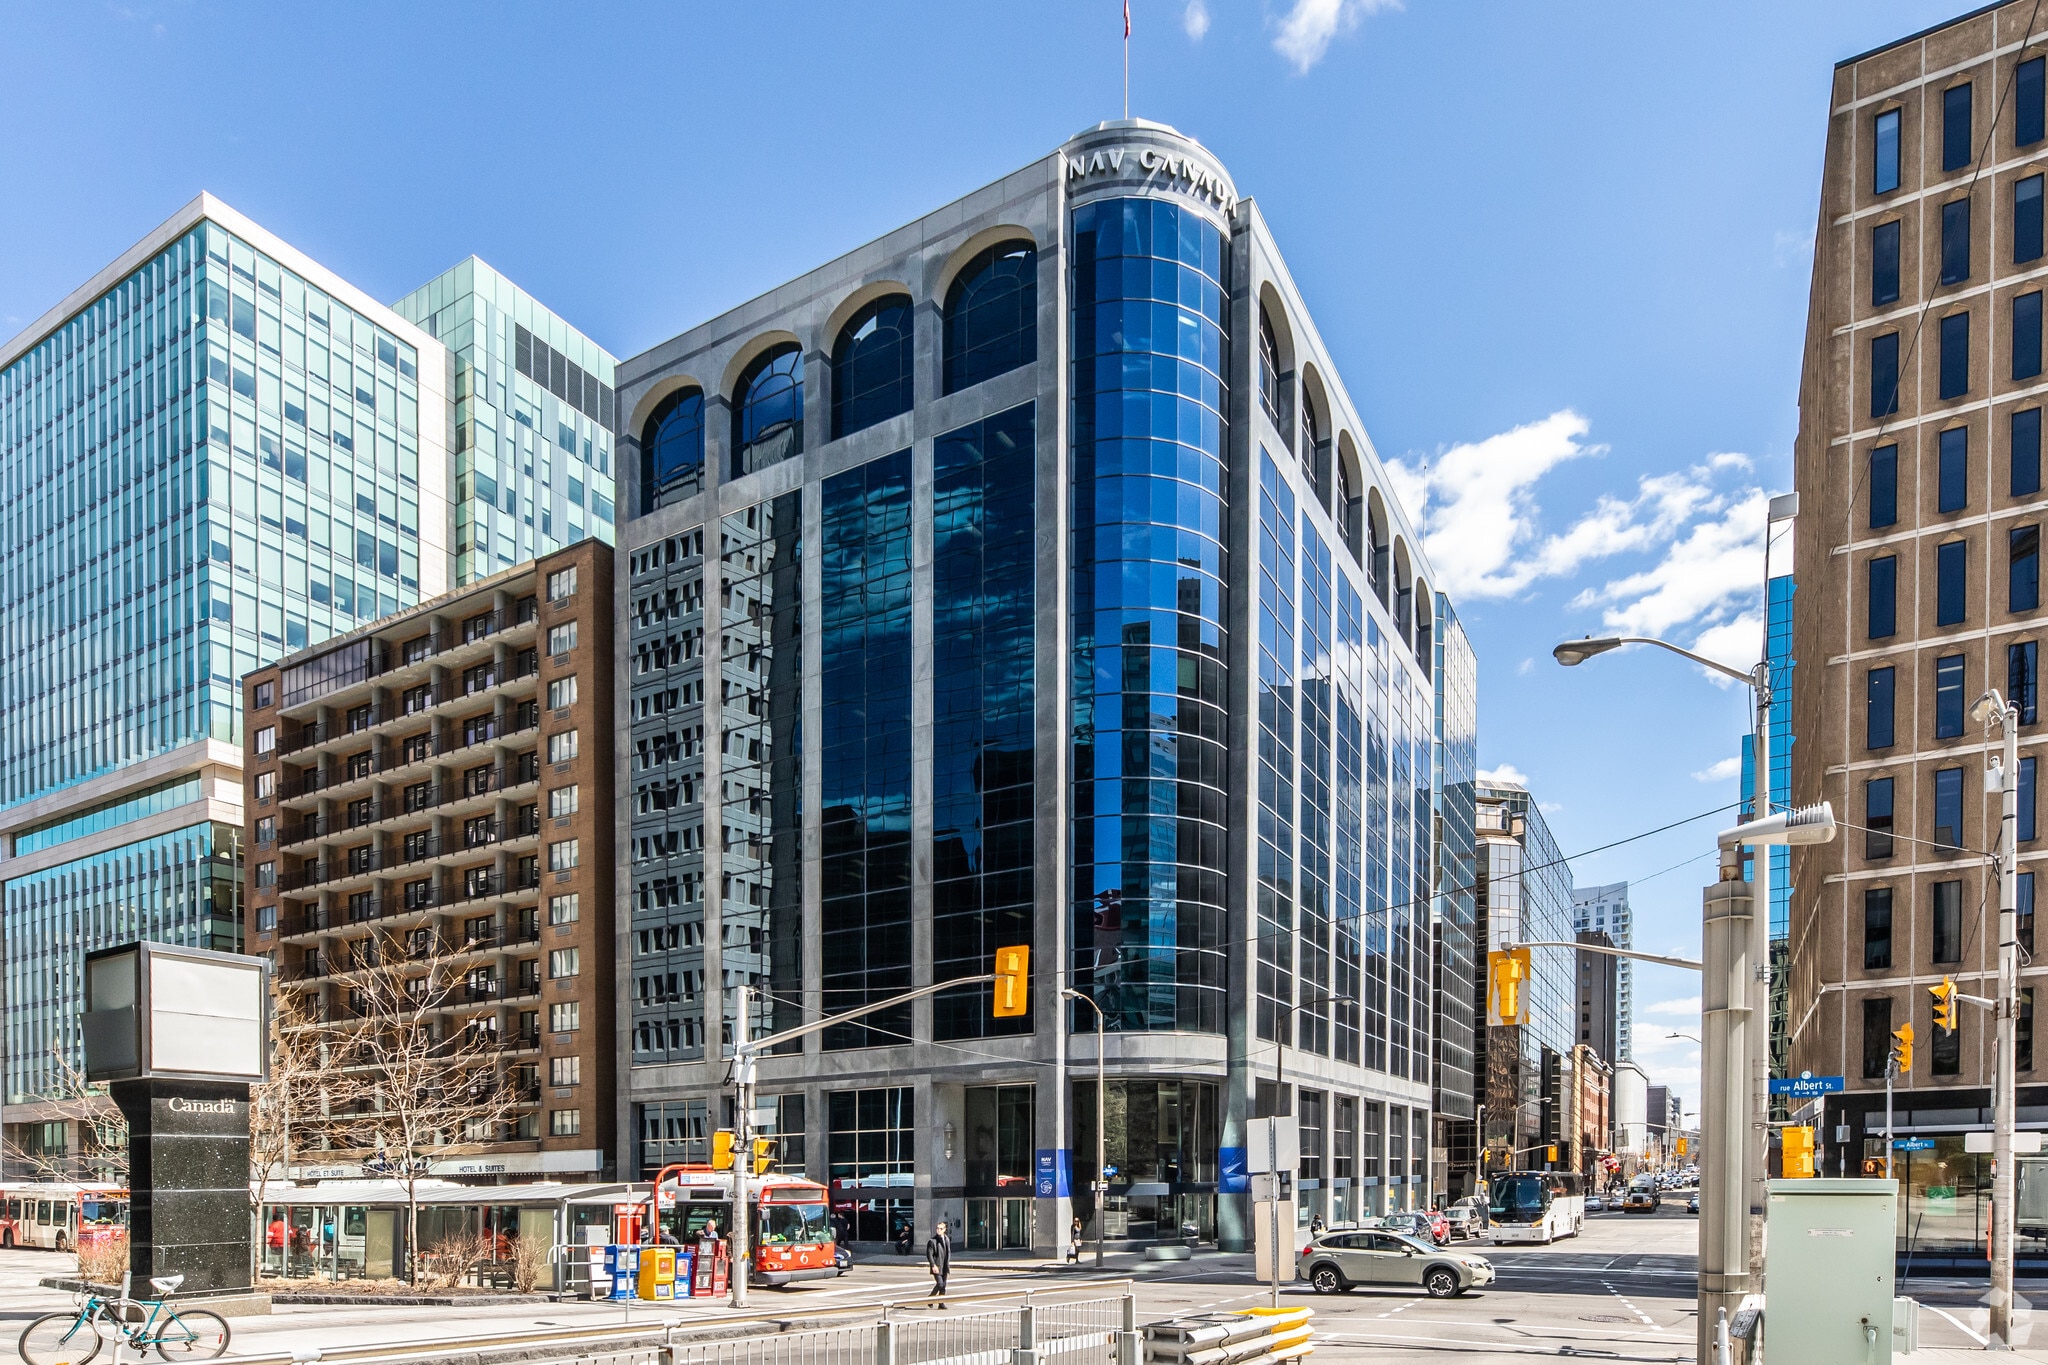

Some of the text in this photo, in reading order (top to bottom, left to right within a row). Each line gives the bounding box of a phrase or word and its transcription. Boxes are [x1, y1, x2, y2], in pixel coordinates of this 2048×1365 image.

[1069, 147, 1237, 220] NAV CANADA
[1793, 1080, 1823, 1091] Albert
[168, 1096, 236, 1114] Canada
[459, 1165, 476, 1173] HOTEL
[485, 1164, 505, 1172] SUITES
